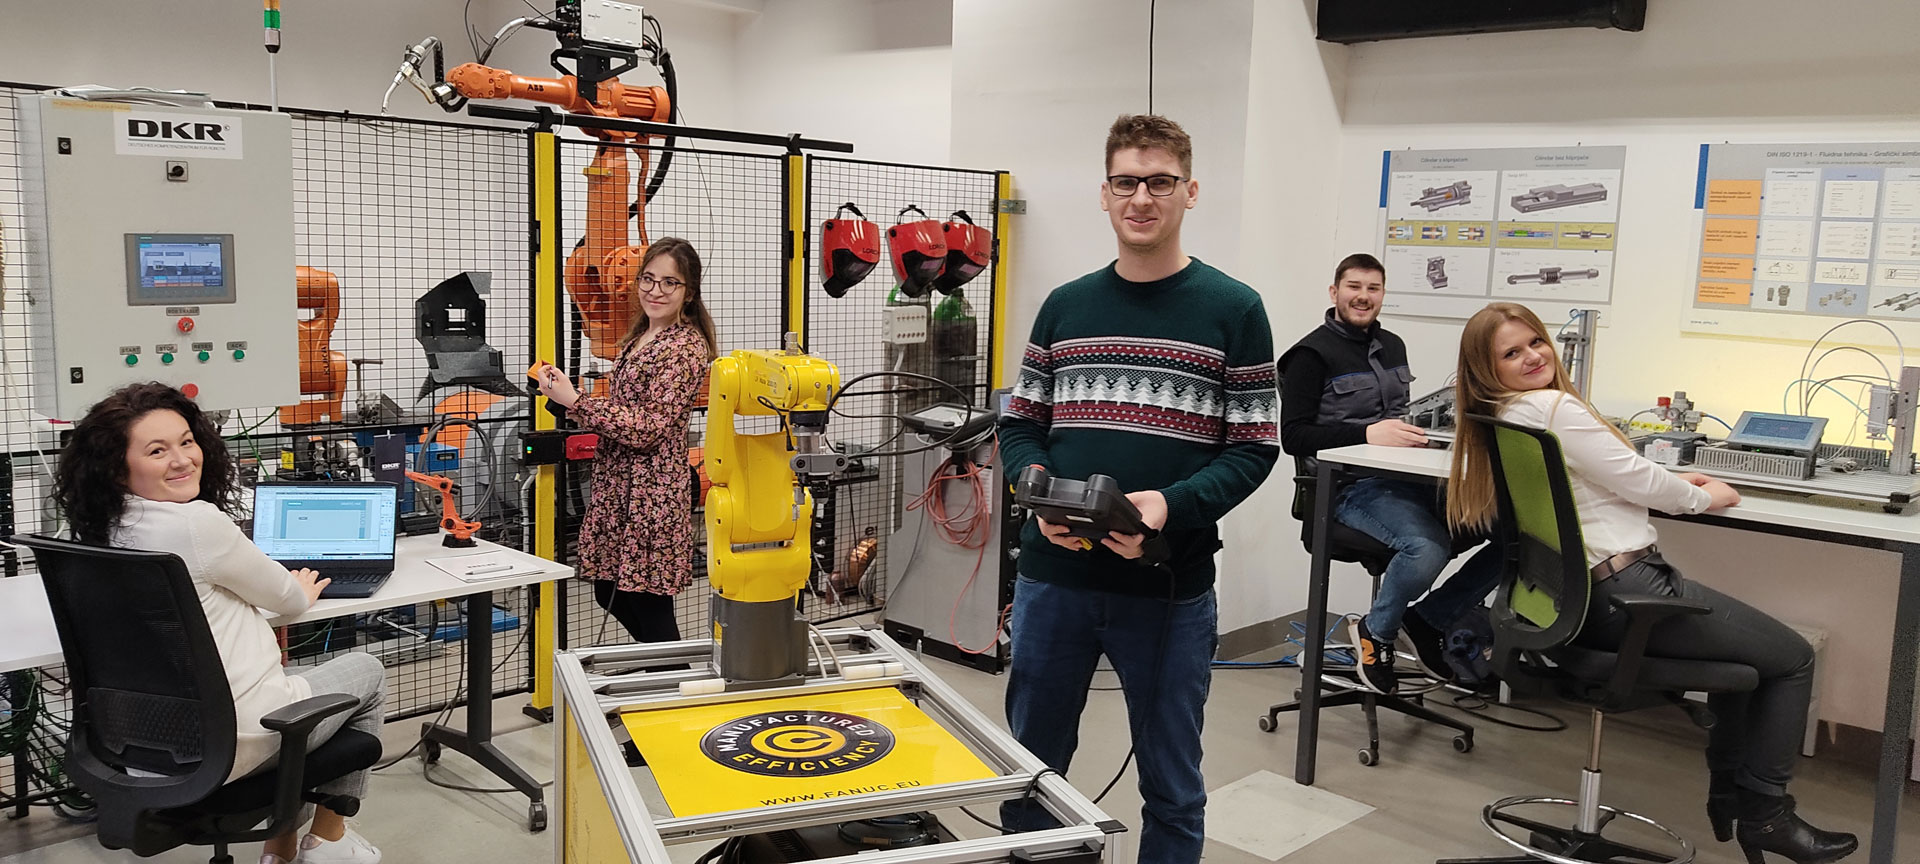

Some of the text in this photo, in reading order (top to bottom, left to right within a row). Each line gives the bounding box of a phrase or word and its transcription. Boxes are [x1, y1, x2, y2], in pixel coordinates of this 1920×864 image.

[128, 119, 225, 141] DKR
[715, 714, 876, 752] MANUFACTURED
[732, 740, 880, 771] EFFICIENCY
[760, 780, 921, 806] WWW.FANUC.EU
